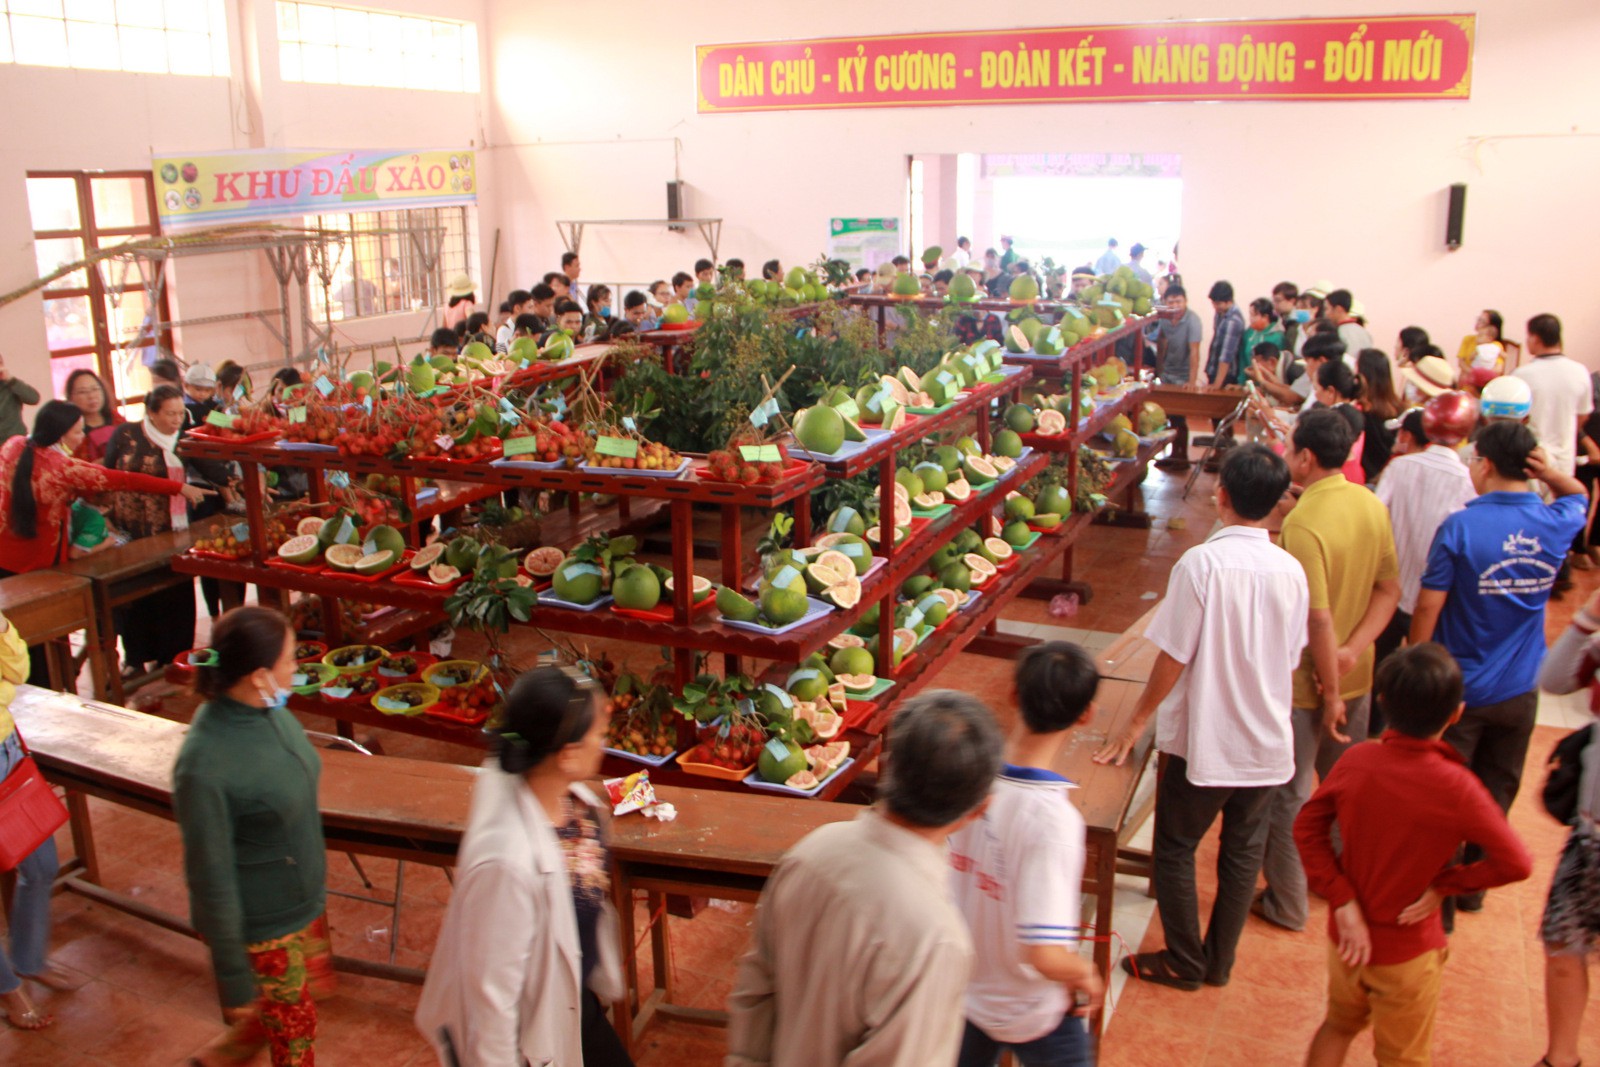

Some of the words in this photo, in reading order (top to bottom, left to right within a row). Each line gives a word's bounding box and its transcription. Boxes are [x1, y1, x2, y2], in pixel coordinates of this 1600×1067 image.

[718, 55, 764, 97] DÂN
[770, 47, 816, 95] CHỦ
[837, 44, 868, 93] KỶ
[874, 49, 957, 92] CƯƠNG
[980, 42, 1051, 88] ĐOÀN
[1058, 35, 1107, 86] KẾT
[1132, 36, 1210, 84] NĂNG
[1217, 34, 1297, 92] ĐỘNG
[1323, 23, 1375, 82] ĐỔI
[1382, 30, 1443, 81] MỚI
[212, 170, 303, 203] KHU
[309, 153, 380, 196] ĐẤU
[385, 154, 446, 192] XẢO
